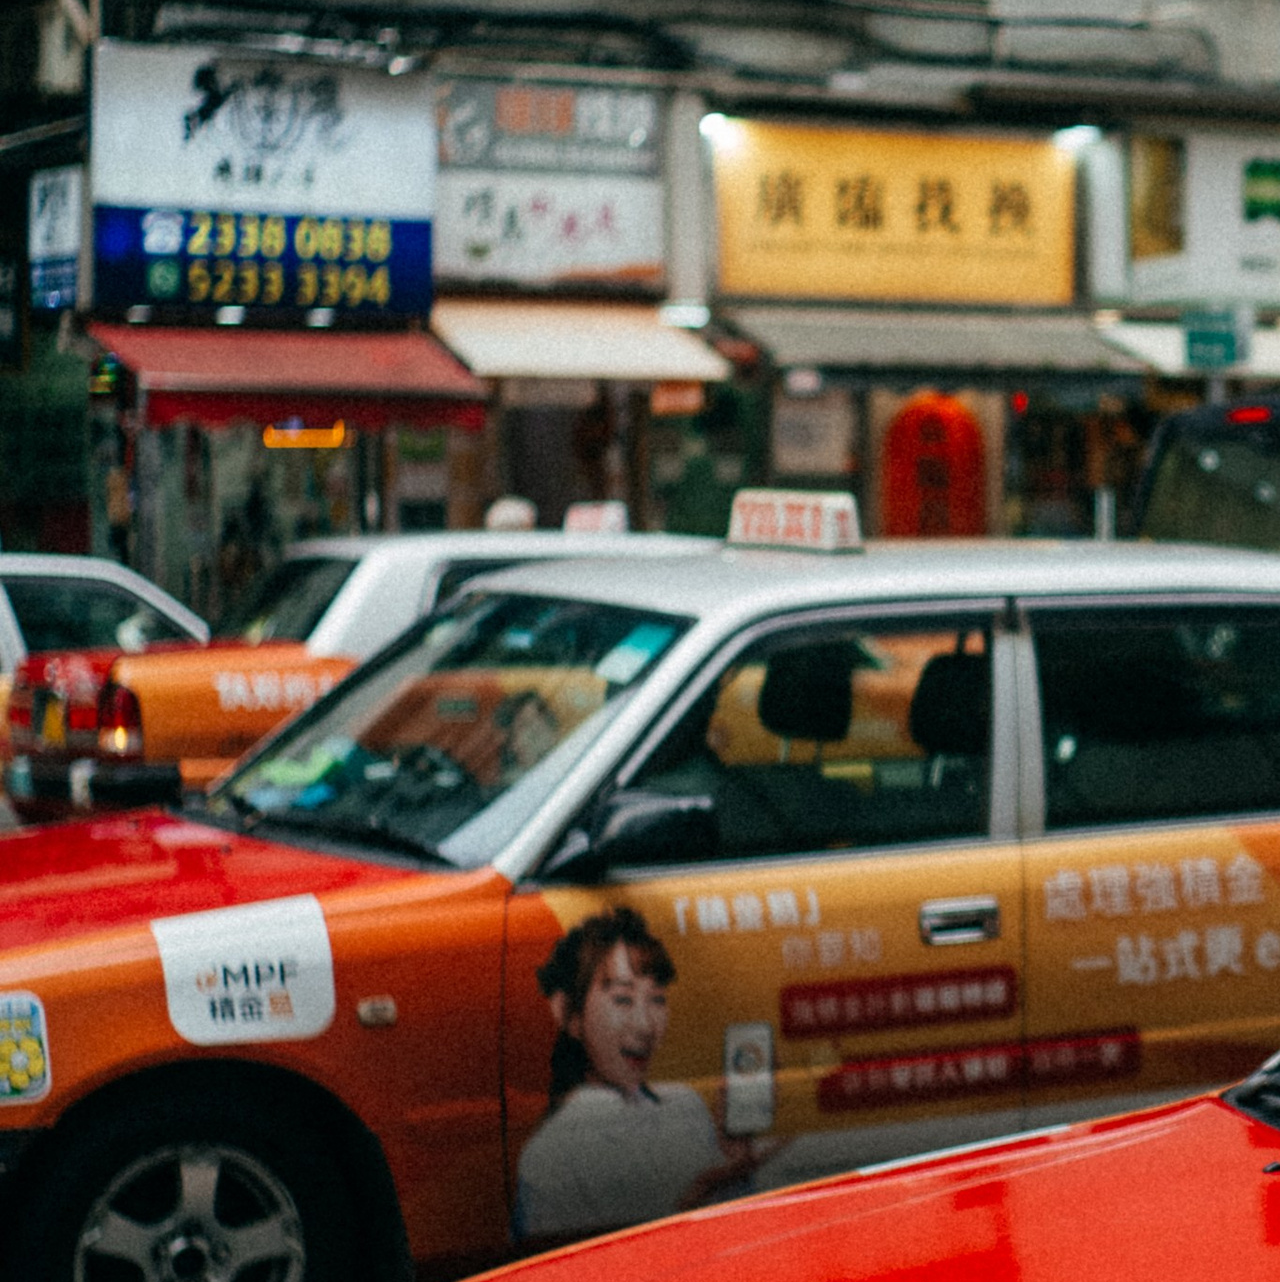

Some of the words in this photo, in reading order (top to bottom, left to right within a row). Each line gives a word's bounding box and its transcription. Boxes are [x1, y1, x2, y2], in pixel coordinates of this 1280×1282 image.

[188, 213, 286, 258] 2338
[1044, 856, 1265, 920] 處理強積金
